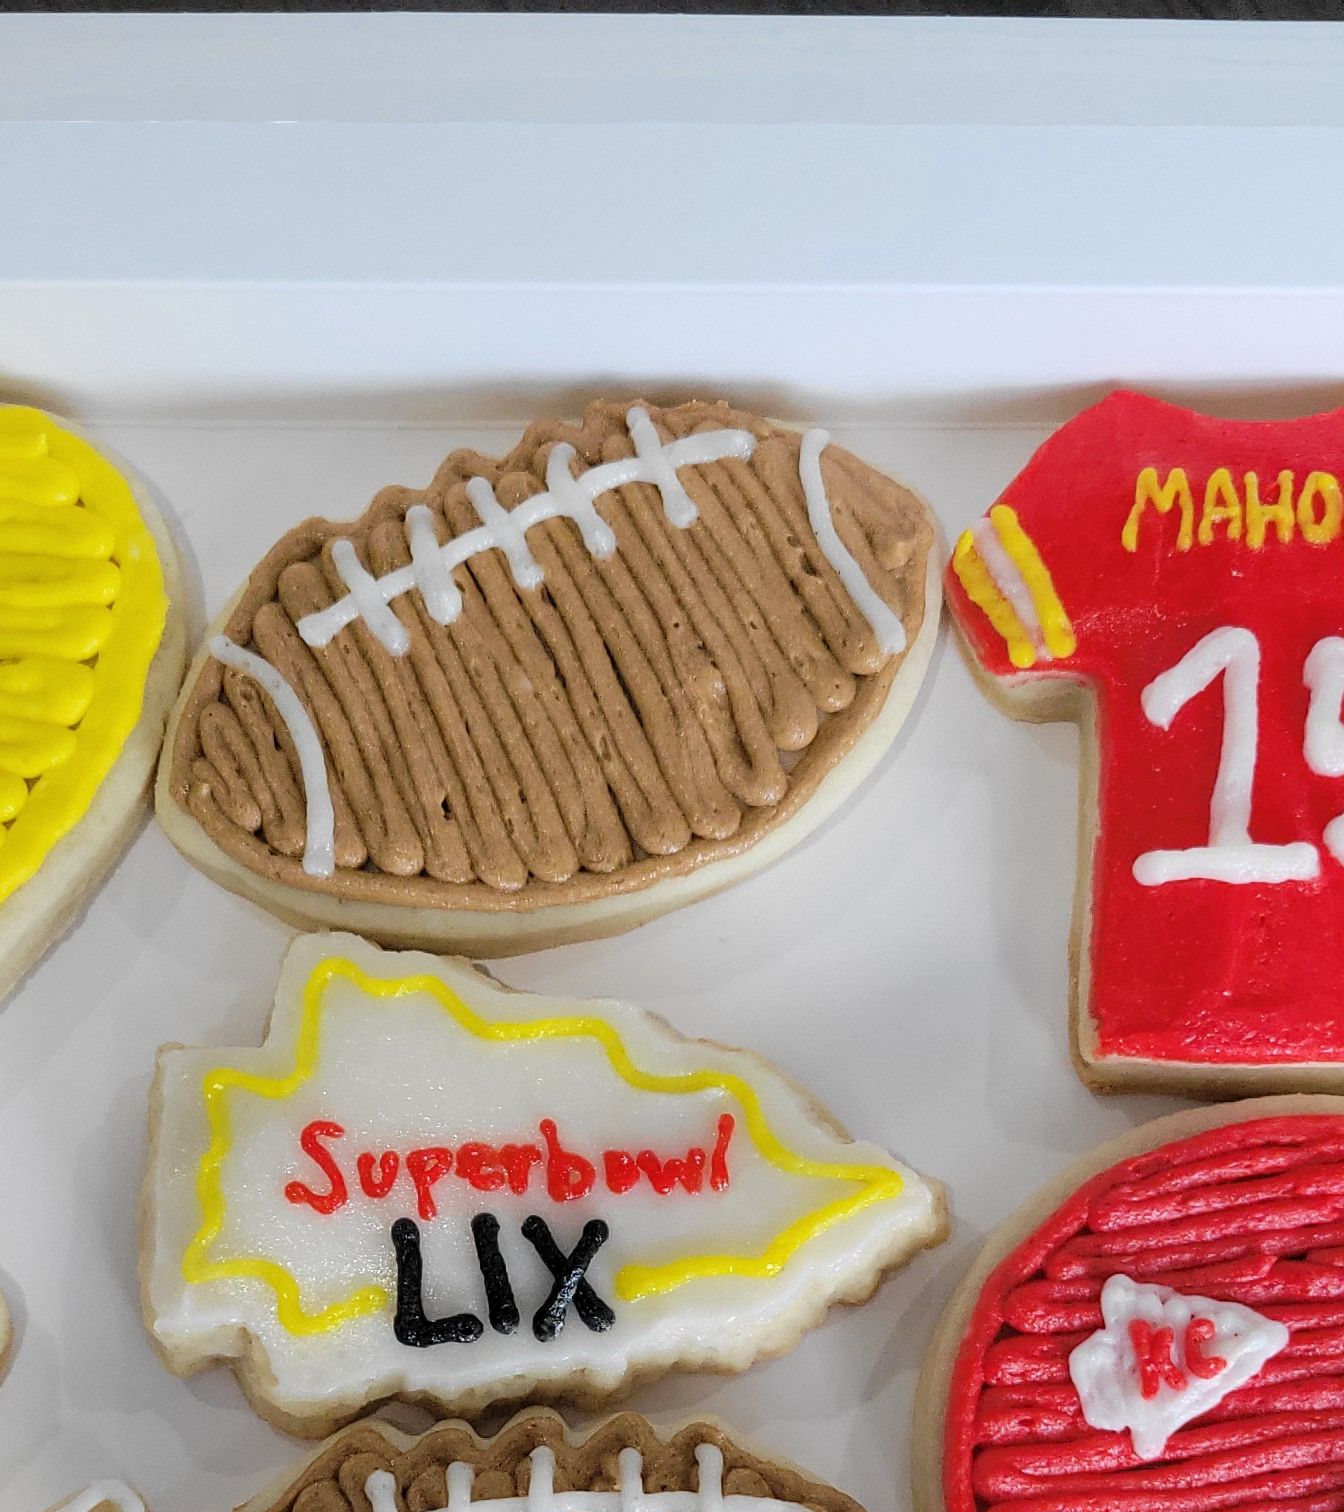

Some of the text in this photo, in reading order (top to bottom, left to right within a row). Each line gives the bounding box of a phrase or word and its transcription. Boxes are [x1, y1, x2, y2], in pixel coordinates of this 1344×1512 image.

[284, 1113, 735, 1220] Superbowl
[391, 1212, 616, 1347] LIX
[1128, 1318, 1227, 1400] KC
